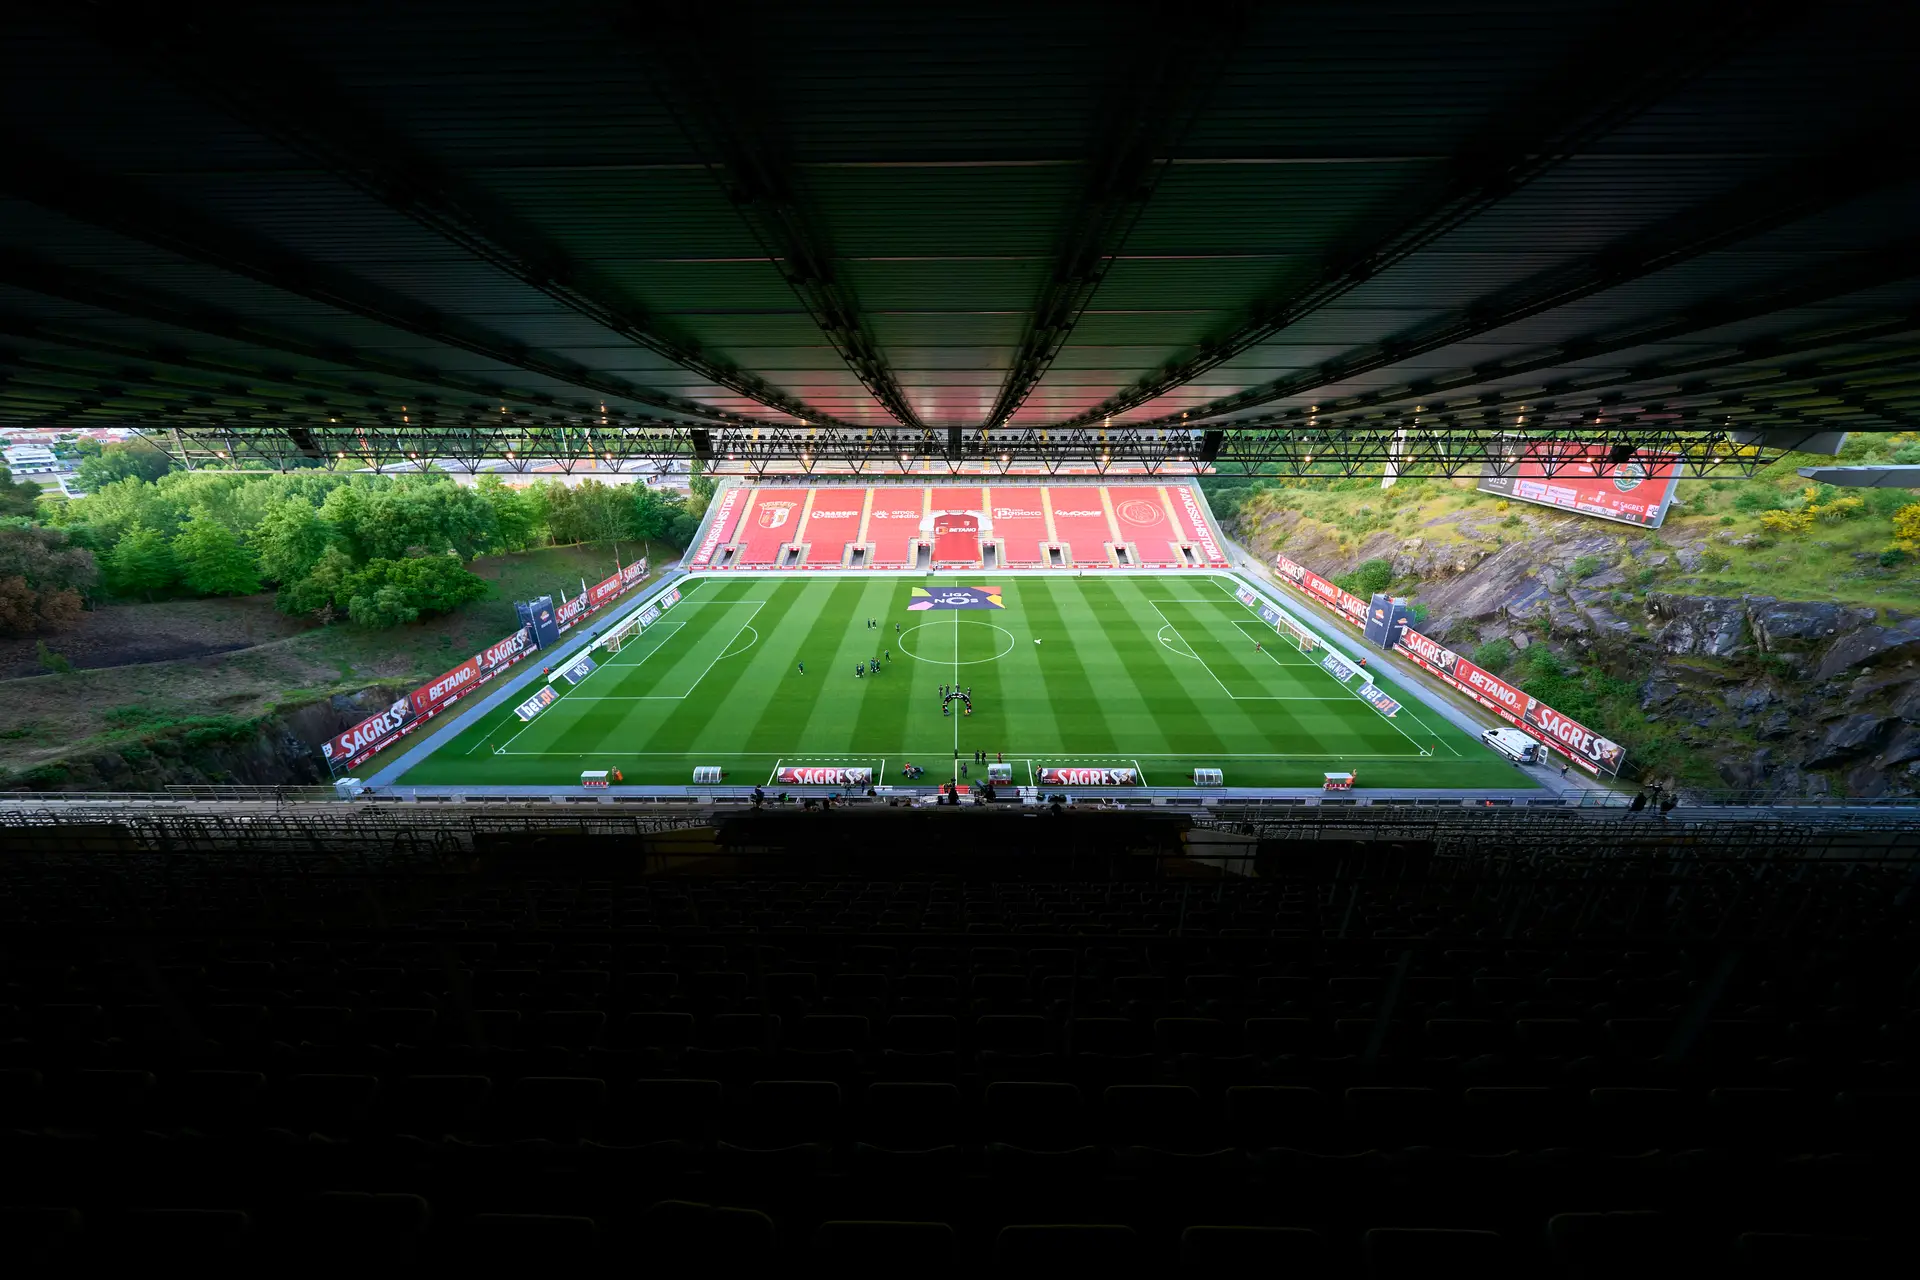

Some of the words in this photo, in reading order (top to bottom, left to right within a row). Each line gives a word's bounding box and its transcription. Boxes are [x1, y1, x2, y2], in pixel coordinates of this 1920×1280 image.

[624, 563, 644, 583] SAGRES
[1281, 560, 1302, 580] SAGRES
[558, 600, 587, 624] SAGRES
[934, 597, 979, 605] NOS
[487, 631, 524, 668] SAGRES
[1408, 633, 1447, 668] SAGRES
[574, 662, 590, 677] NOS
[521, 688, 555, 717] bet.pt
[1360, 684, 1395, 713] bet.pt
[341, 707, 403, 758] SAGRES
[1537, 708, 1605, 761] SAGRES
[793, 768, 855, 784] SAGRES
[1057, 769, 1120, 786] SAGRES
